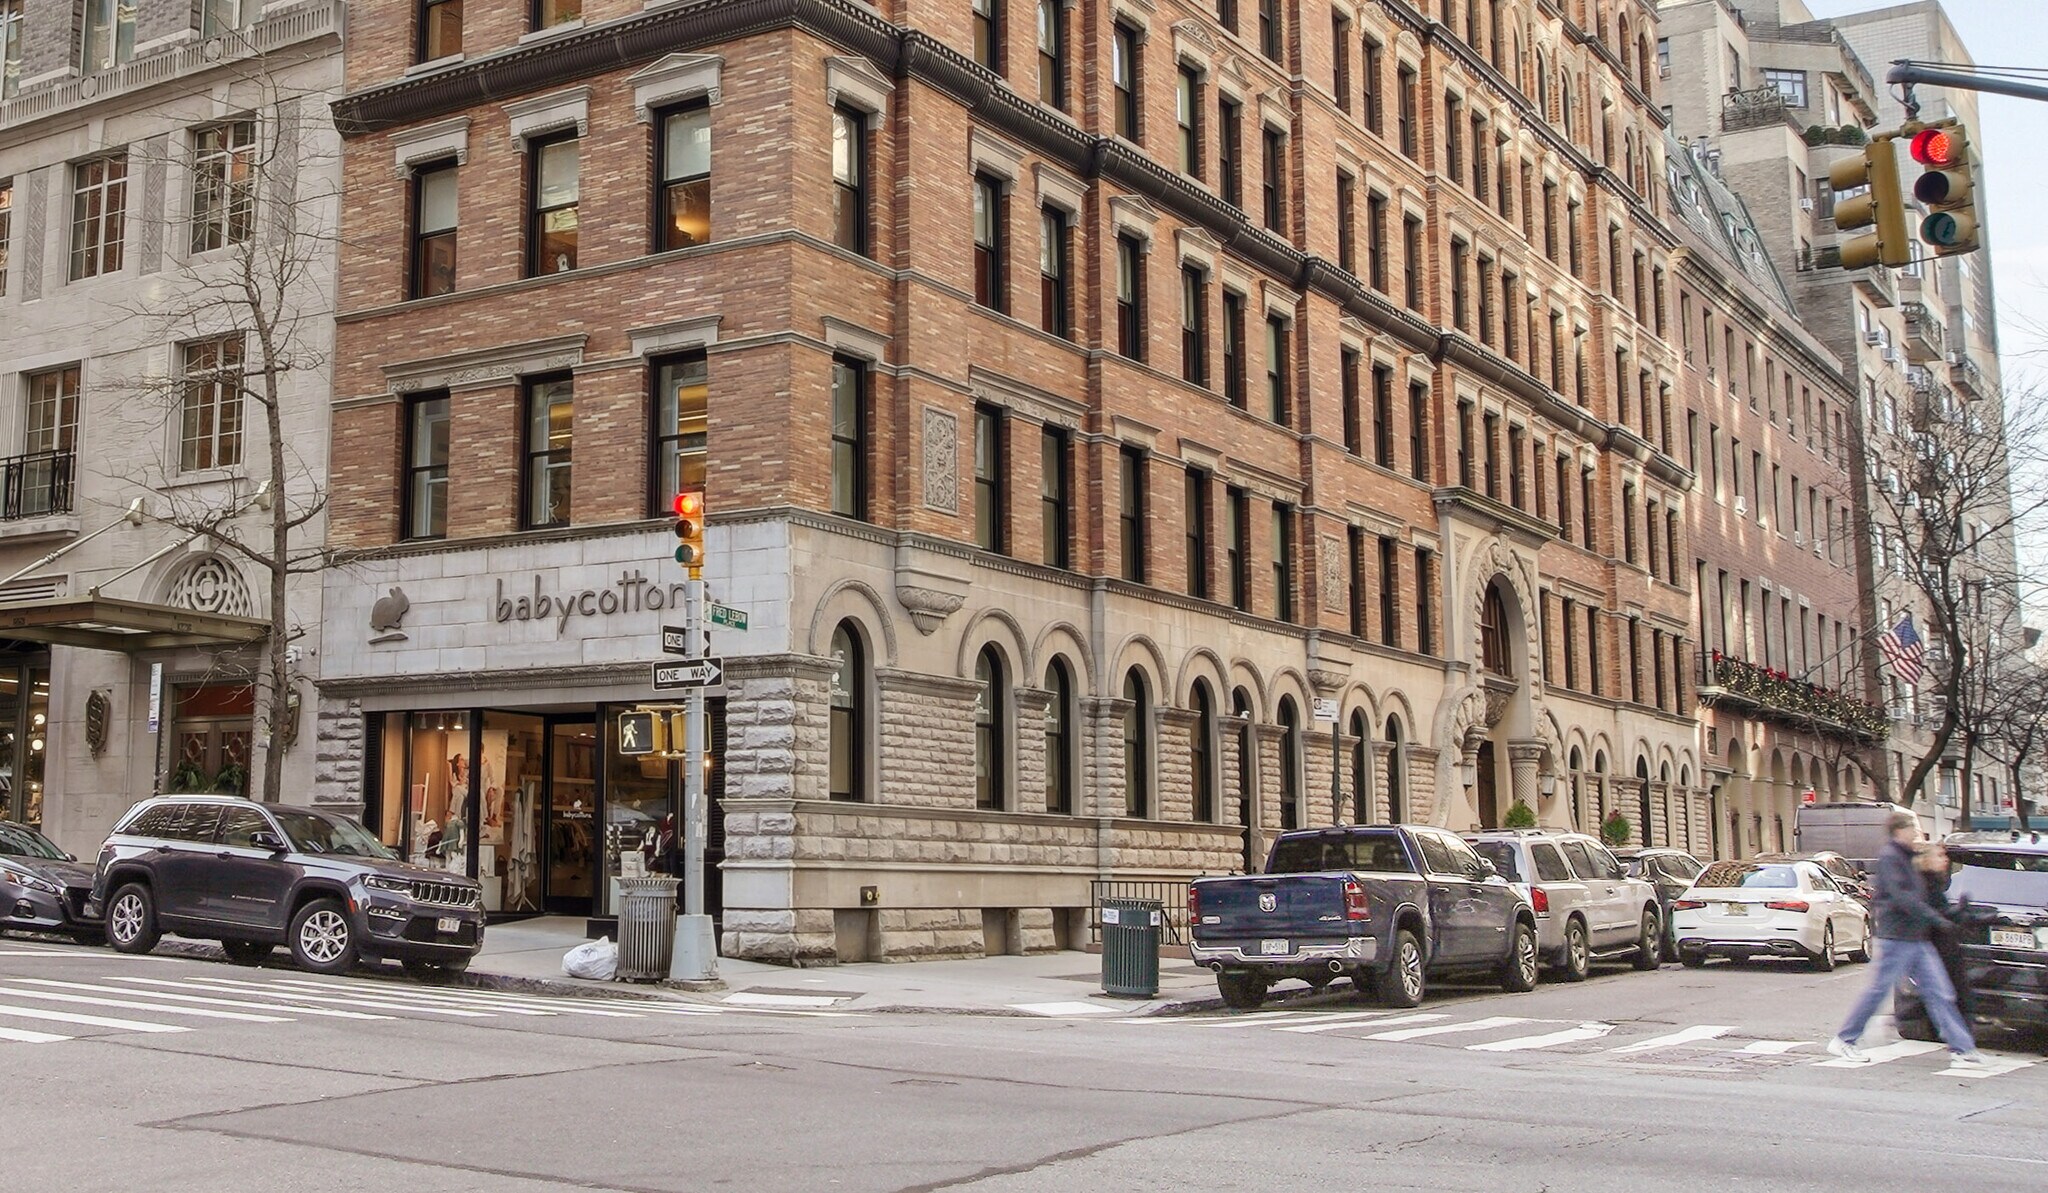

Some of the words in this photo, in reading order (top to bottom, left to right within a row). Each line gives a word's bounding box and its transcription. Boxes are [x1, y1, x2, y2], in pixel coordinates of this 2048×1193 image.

[712, 605, 728, 619] FRED
[729, 609, 747, 624] LEBOW
[723, 619, 736, 628] PLACE
[666, 634, 682, 647] ONE
[659, 670, 680, 681] ONE
[690, 666, 713, 679] WAY
